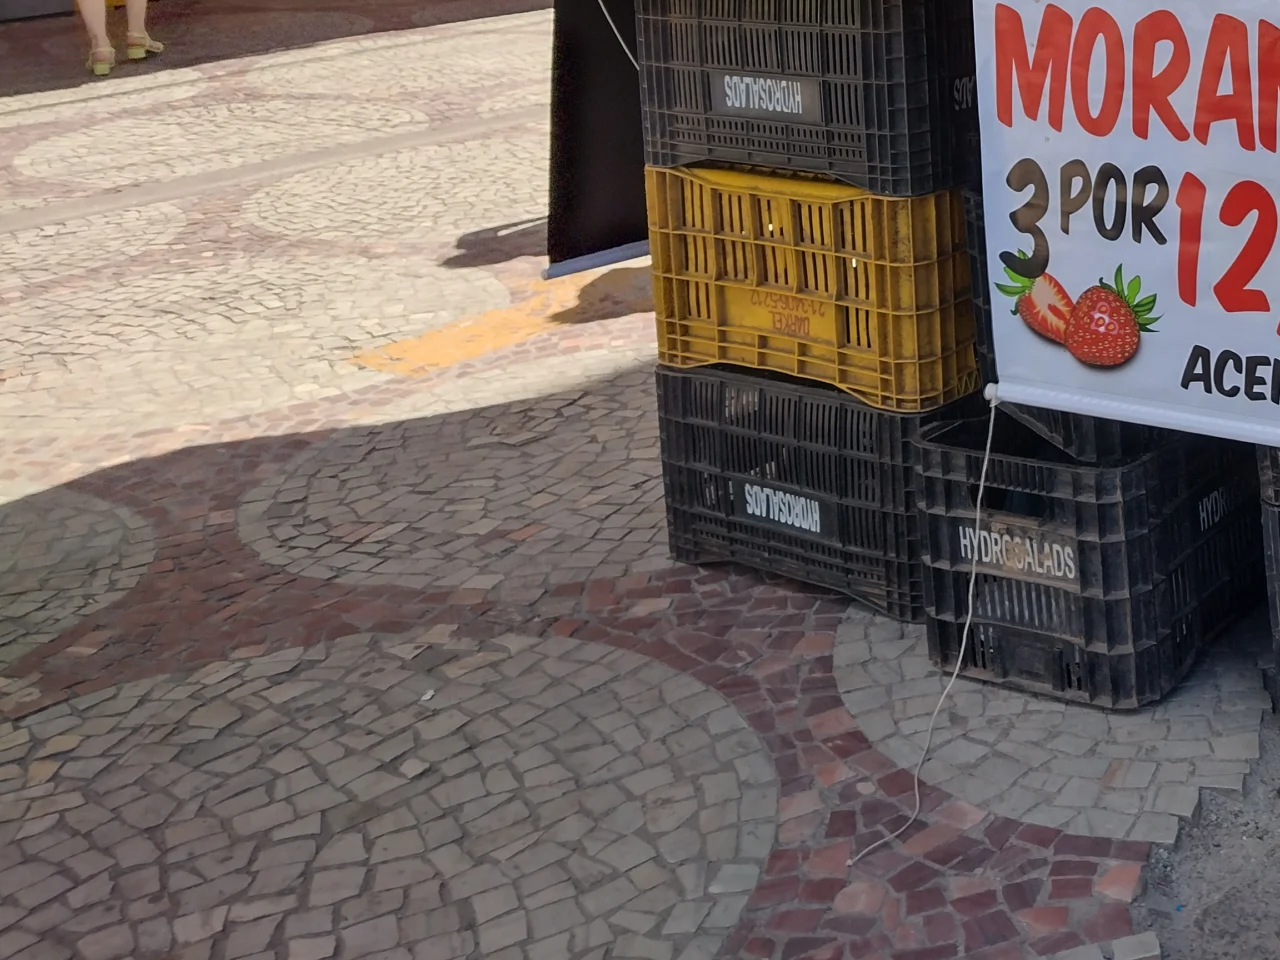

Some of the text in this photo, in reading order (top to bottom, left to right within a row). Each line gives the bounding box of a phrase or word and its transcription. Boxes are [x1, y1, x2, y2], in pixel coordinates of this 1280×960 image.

[724, 75, 803, 114] HYDROSALADS
[999, 158, 1050, 279] 3
[1059, 158, 1170, 246] POR
[744, 483, 821, 533] HYDROSALADS
[958, 526, 1076, 579] HYDROSALADS
